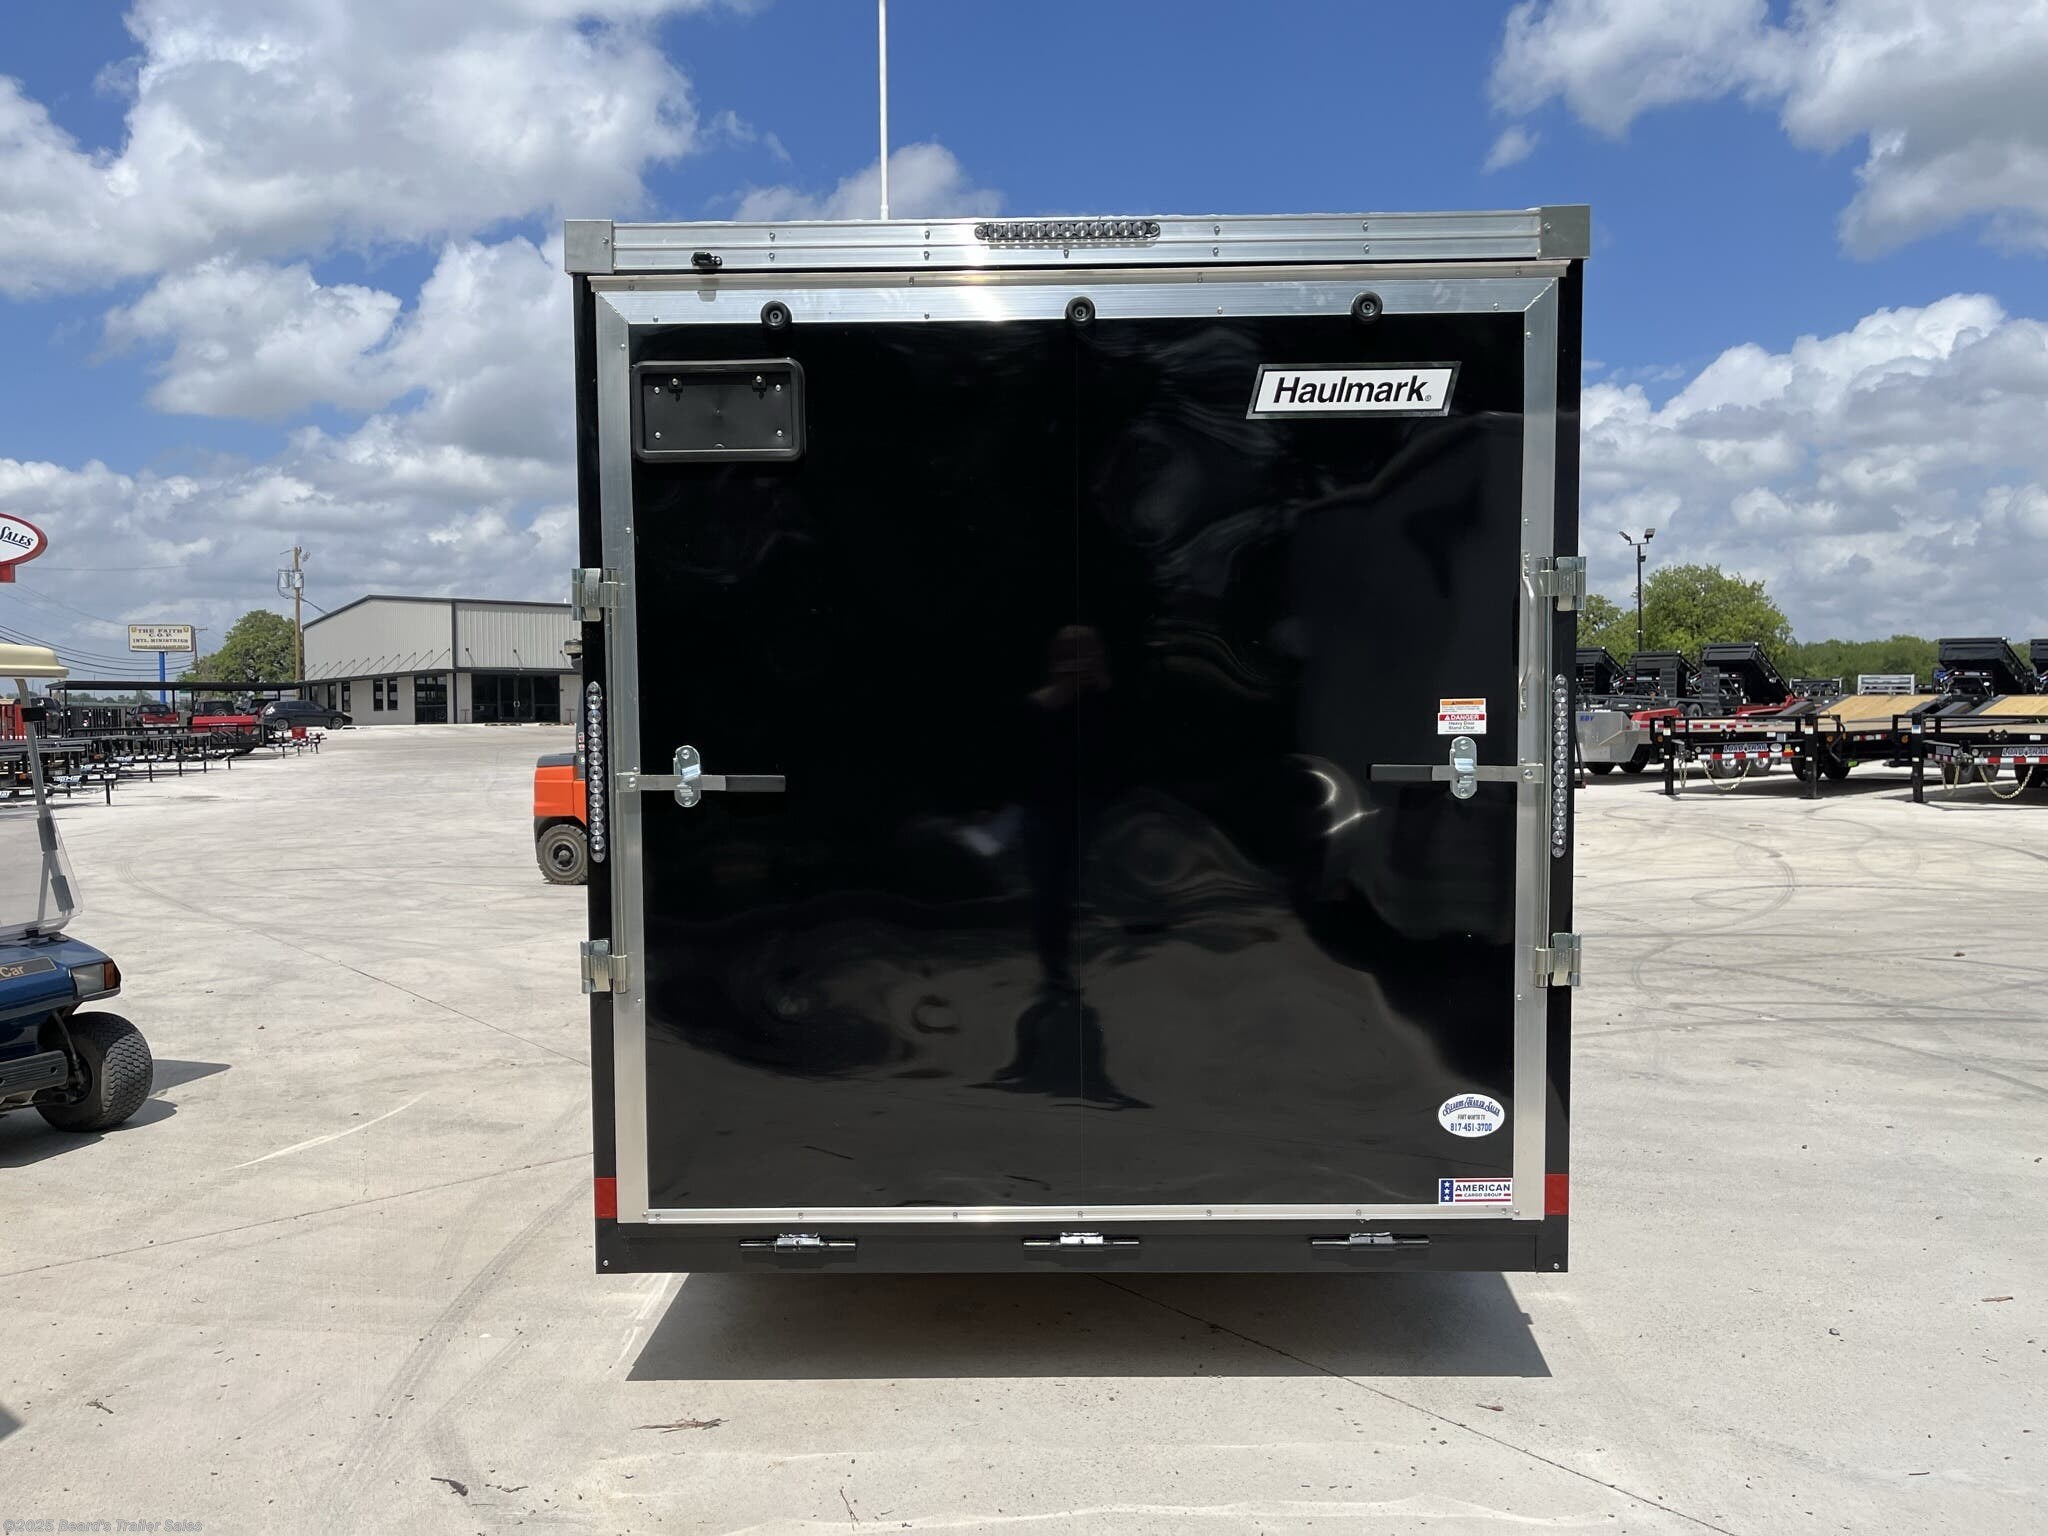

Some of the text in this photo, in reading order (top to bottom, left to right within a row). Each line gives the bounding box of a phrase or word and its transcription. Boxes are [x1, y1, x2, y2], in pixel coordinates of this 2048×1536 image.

[1273, 375, 1429, 404] Haulmark
[0, 526, 34, 547] SALES
[0, 965, 24, 978] Car
[1450, 1122, 1493, 1132] 817-451-3700
[1455, 1183, 1510, 1192] AMERICAN
